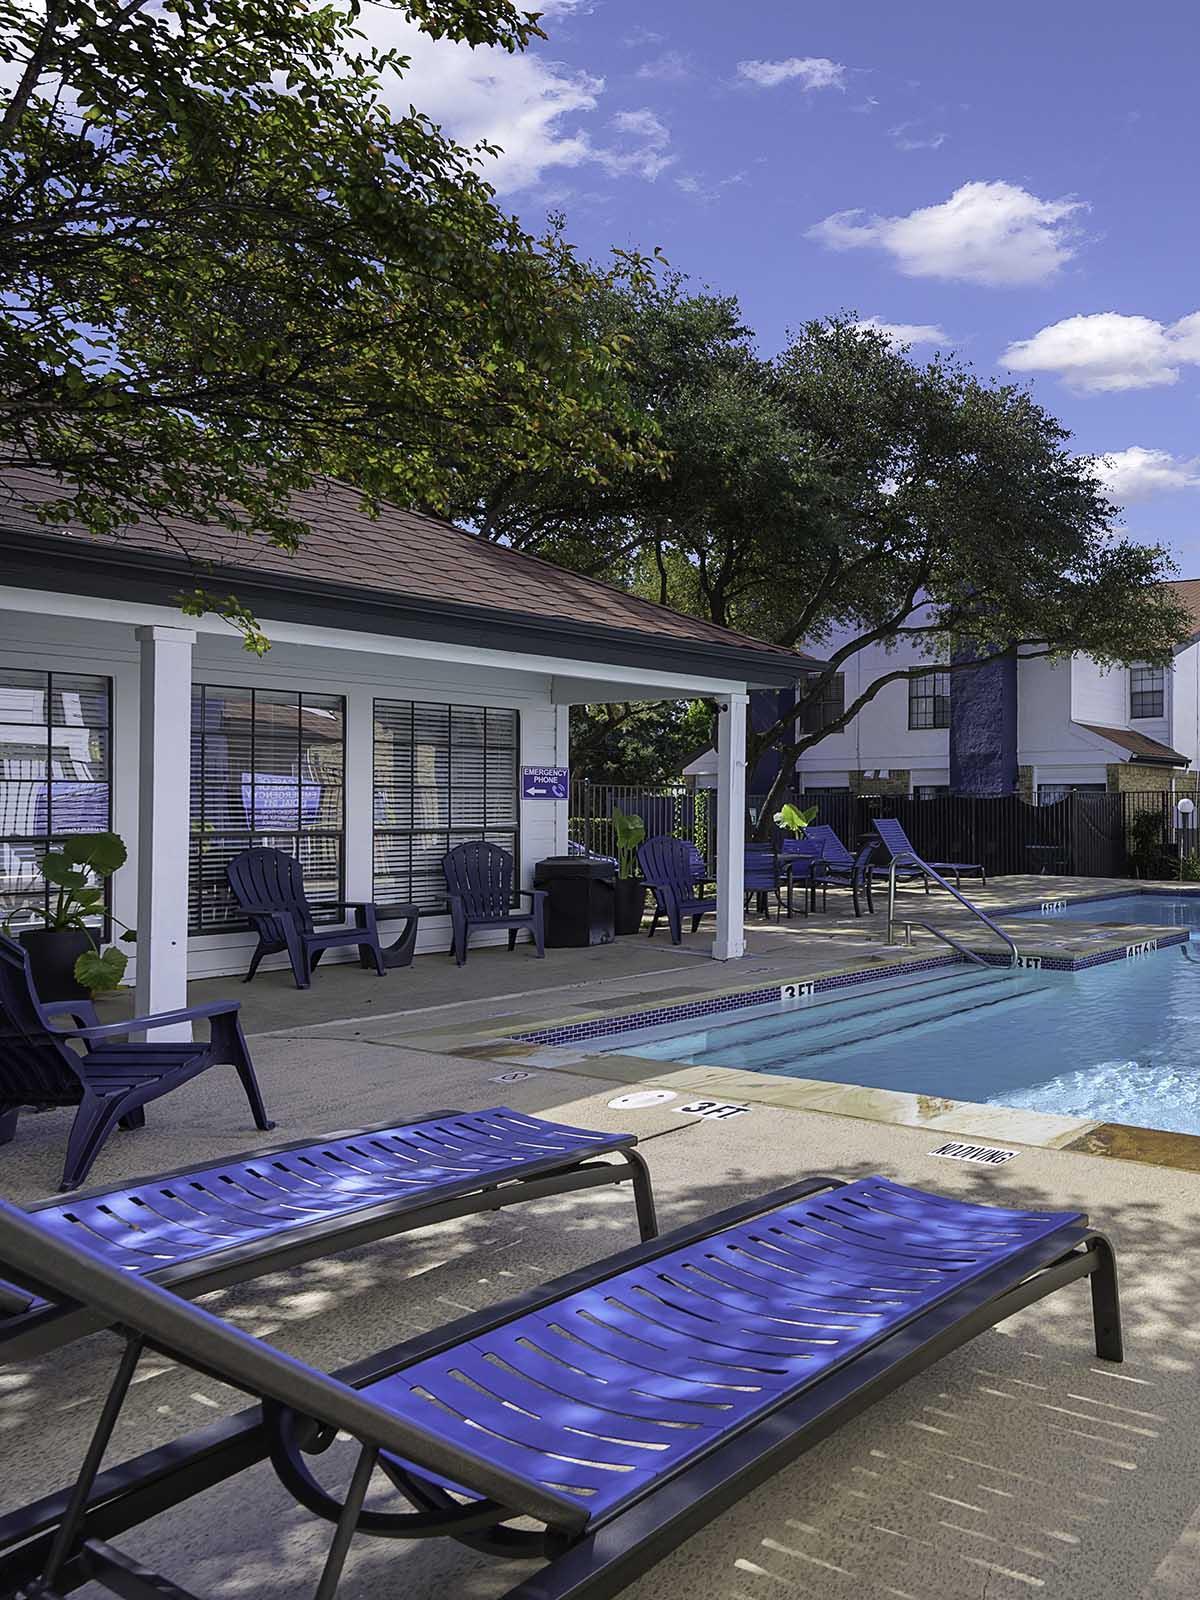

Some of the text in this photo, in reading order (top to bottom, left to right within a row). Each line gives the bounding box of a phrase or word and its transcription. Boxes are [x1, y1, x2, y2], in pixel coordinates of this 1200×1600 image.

[524, 768, 567, 776] EMERGENCY
[798, 982, 814, 997] FT
[681, 1102, 716, 1113] 3
[951, 1146, 1014, 1164] DIVING
